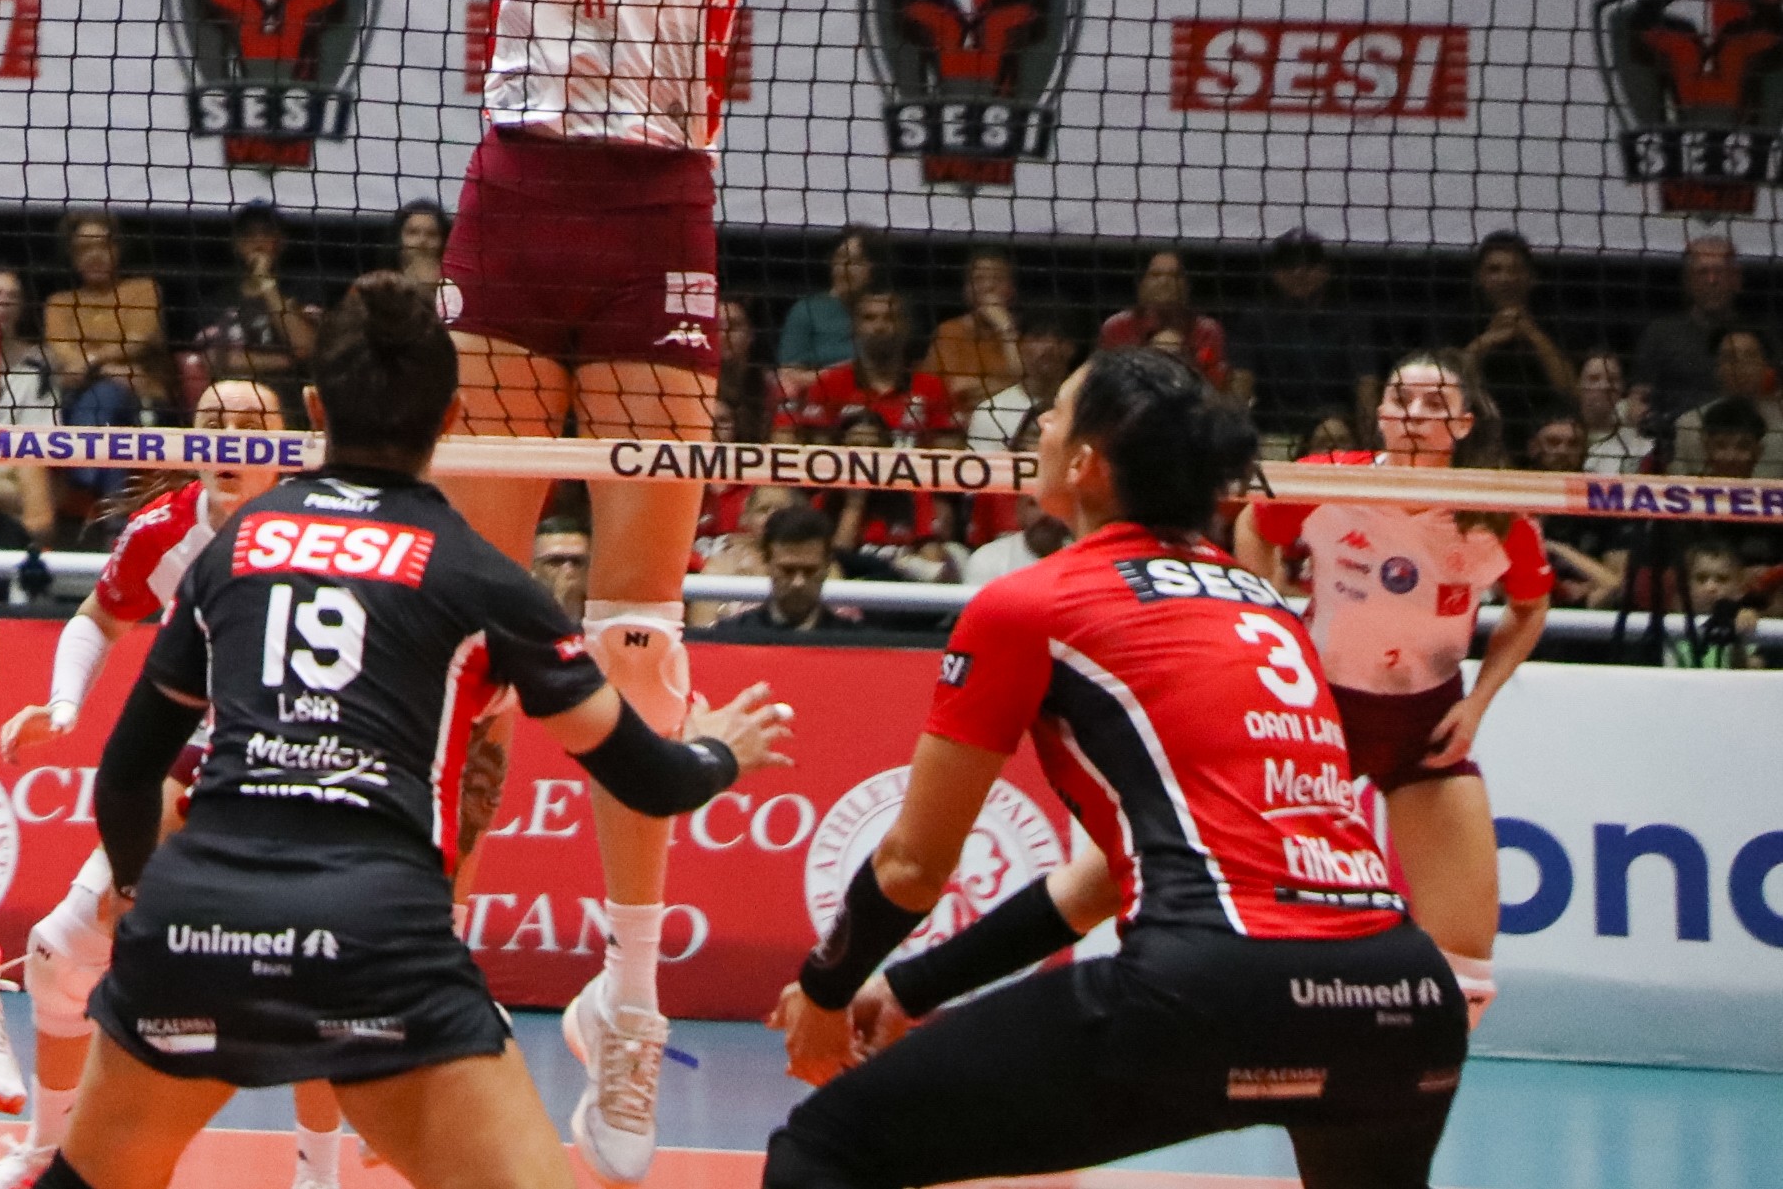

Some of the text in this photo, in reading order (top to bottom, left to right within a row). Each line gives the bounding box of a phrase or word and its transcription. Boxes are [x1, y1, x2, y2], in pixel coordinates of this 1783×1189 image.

[1195, 28, 1443, 111] SESI
[200, 88, 339, 135] SESI
[897, 105, 1040, 153] SESI
[1635, 132, 1783, 180] SESI
[182, 434, 304, 467] REDE
[608, 441, 992, 491] CAMPEONATO
[248, 519, 415, 576] SESI
[1146, 558, 1287, 609] SESI
[262, 583, 367, 691] 19
[1234, 612, 1319, 708] 3
[167, 923, 296, 957] Unimed
[1290, 977, 1413, 1007] Unimed
